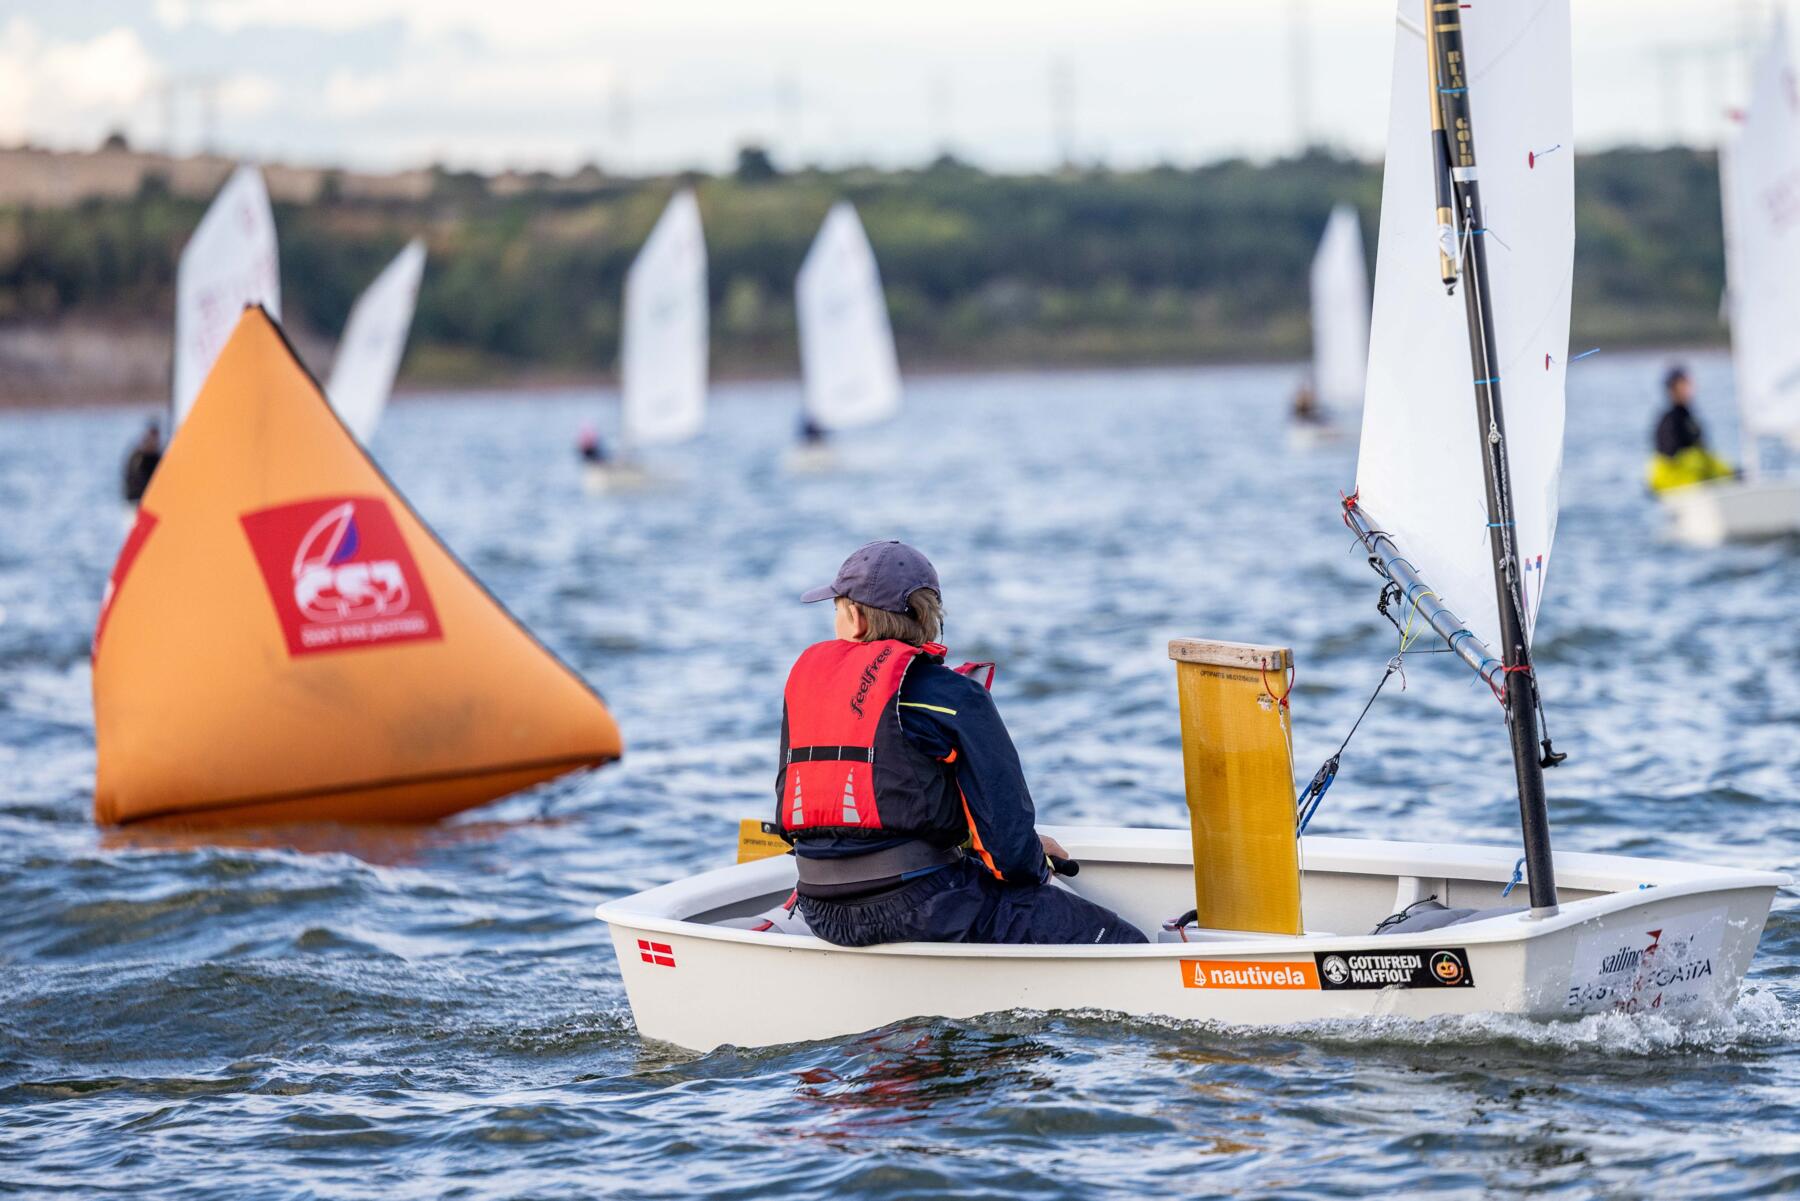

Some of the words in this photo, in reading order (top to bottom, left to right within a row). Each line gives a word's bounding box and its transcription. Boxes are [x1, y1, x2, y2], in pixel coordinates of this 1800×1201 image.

[850, 646, 892, 719] feelfree
[1348, 955, 1422, 969] GOTTIFREDI
[1210, 965, 1305, 985] nautivela
